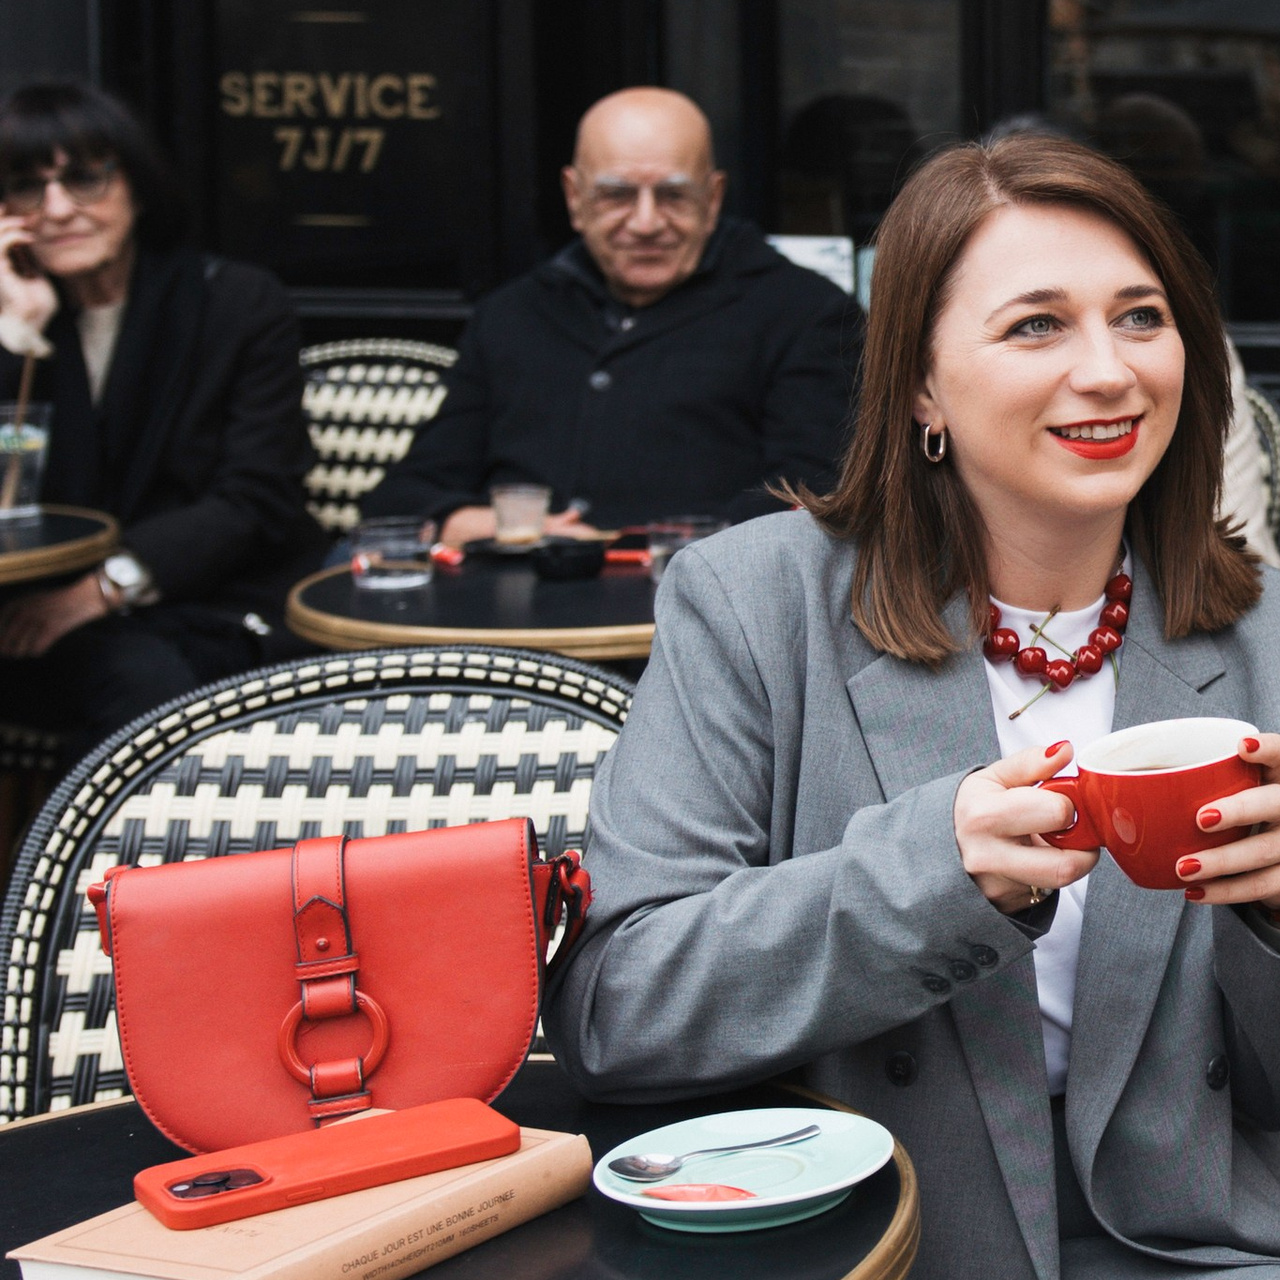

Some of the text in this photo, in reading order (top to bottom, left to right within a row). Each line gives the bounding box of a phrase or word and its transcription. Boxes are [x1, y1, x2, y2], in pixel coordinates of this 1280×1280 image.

[221, 72, 438, 119] SERVICE
[274, 127, 386, 172] 7J/7
[341, 1250, 379, 1274] CHAQUE
[381, 1238, 406, 1257] JOUR
[407, 1230, 425, 1245] EST
[426, 1221, 444, 1236] UNE
[445, 1206, 476, 1228] BONNE
